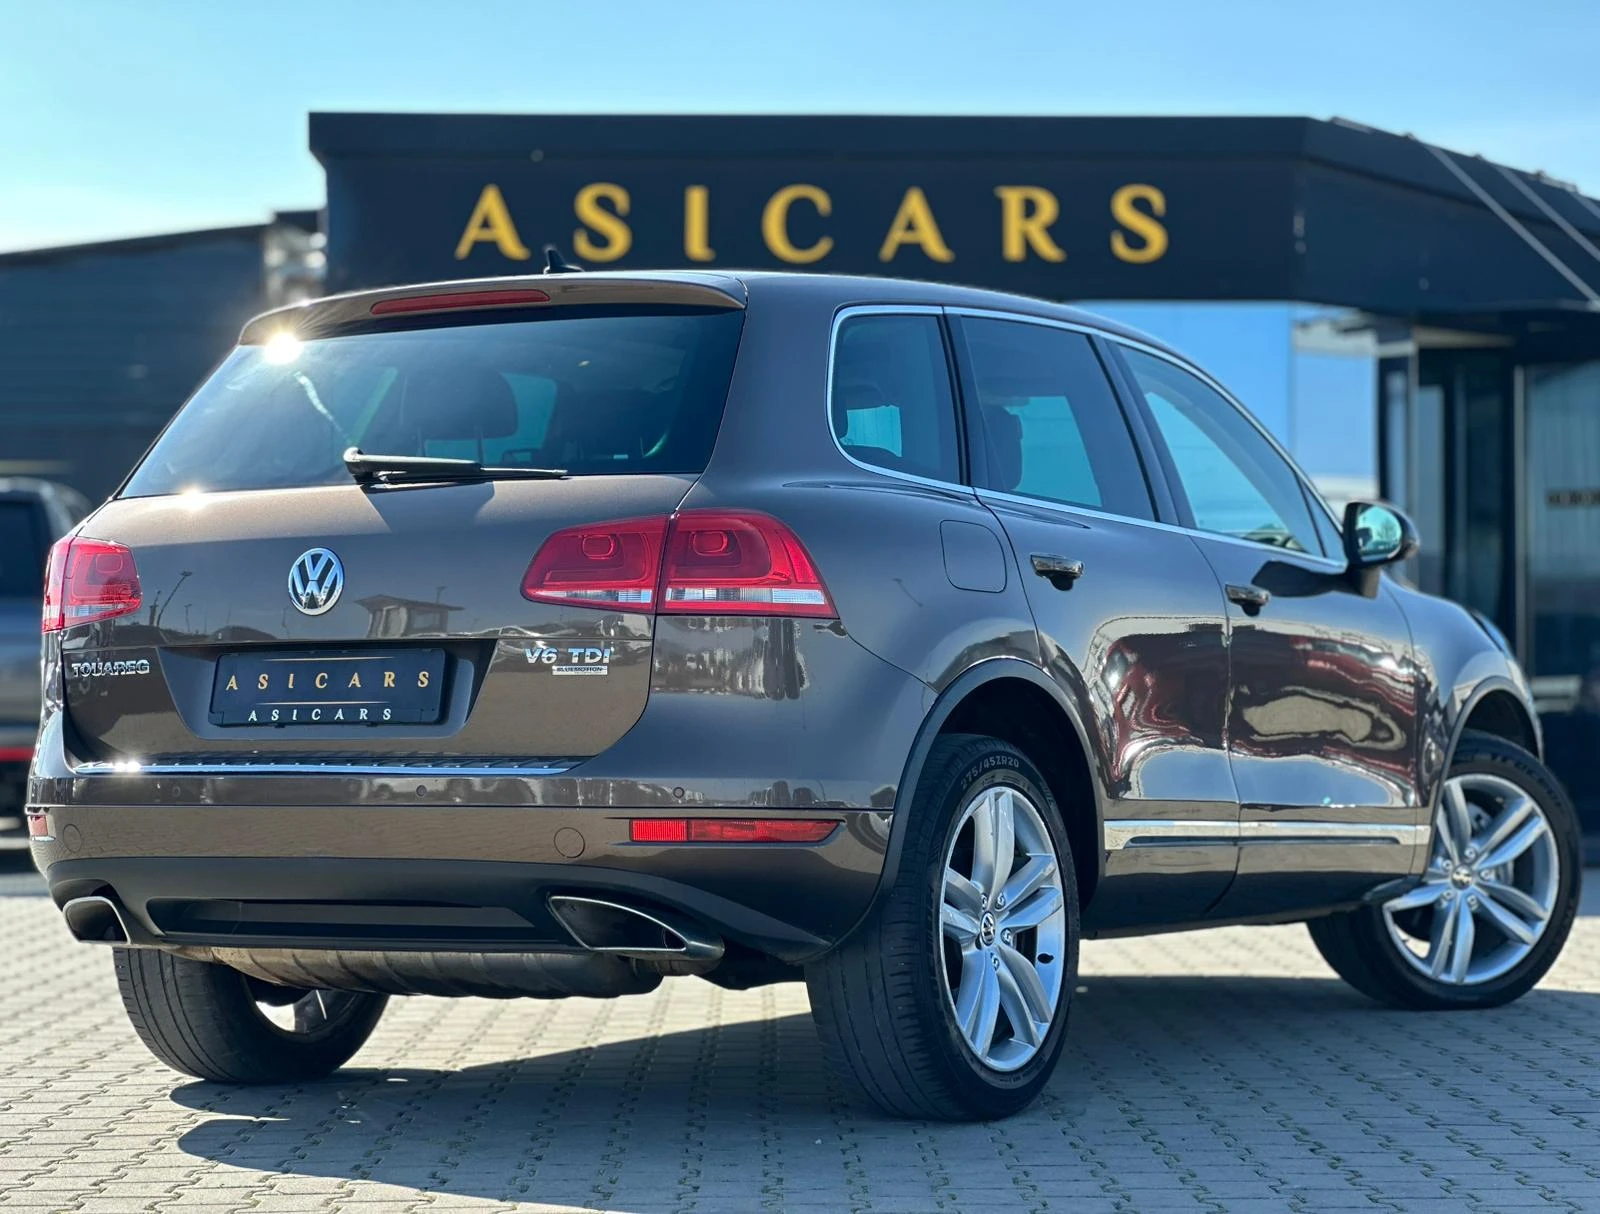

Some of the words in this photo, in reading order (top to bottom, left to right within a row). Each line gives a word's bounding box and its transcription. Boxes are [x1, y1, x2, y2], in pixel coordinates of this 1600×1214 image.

[455, 182, 1168, 263] ASICARS
[524, 647, 557, 664] V6
[567, 647, 611, 664] TDI
[71, 659, 150, 678] TOUAREG
[226, 671, 430, 691] ASICARS
[248, 708, 392, 721] ASICARS
